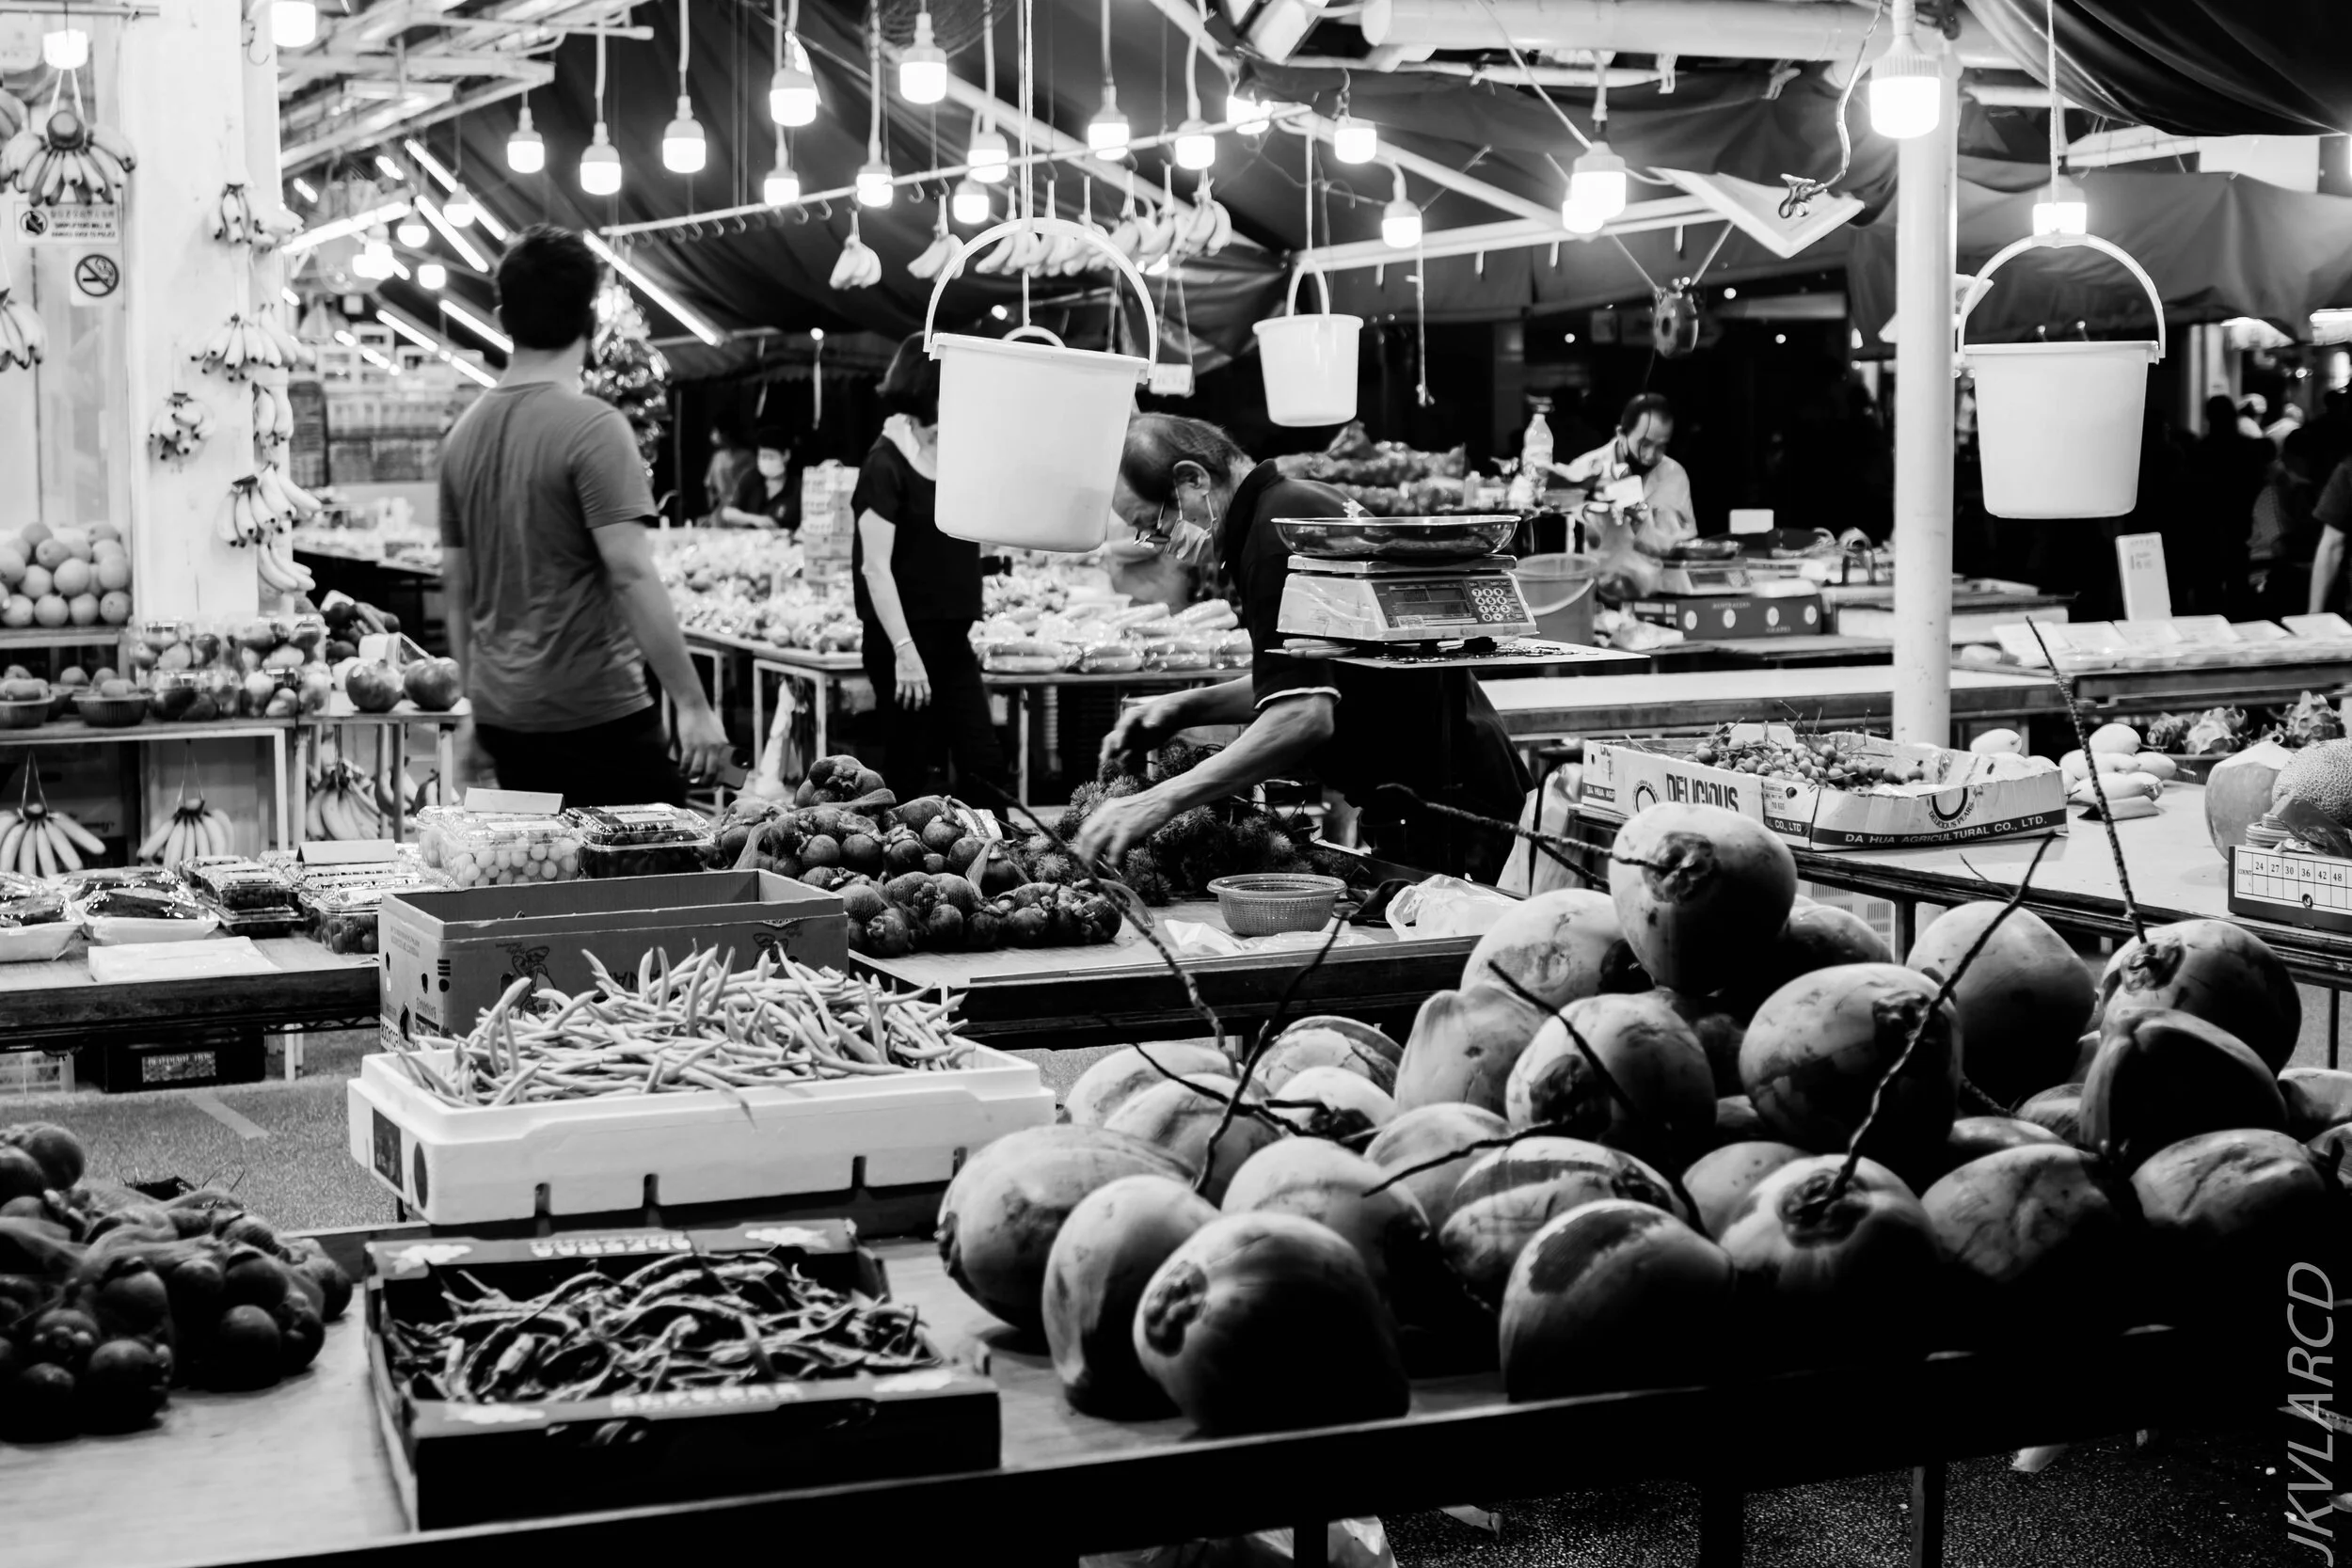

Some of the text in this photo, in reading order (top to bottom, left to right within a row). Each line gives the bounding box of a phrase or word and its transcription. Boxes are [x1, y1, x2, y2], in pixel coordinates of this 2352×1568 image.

[1666, 773, 1740, 813] DELICIOUS
[1845, 816, 2048, 844] DA HUA AGRICULTURAL CO., LTD.
[2255, 862, 2264, 871] 24
[2270, 863, 2280, 873] 27
[2285, 866, 2295, 875] 30
[2301, 868, 2311, 878] 36
[2317, 871, 2328, 879] 42
[2333, 873, 2343, 882] 48
